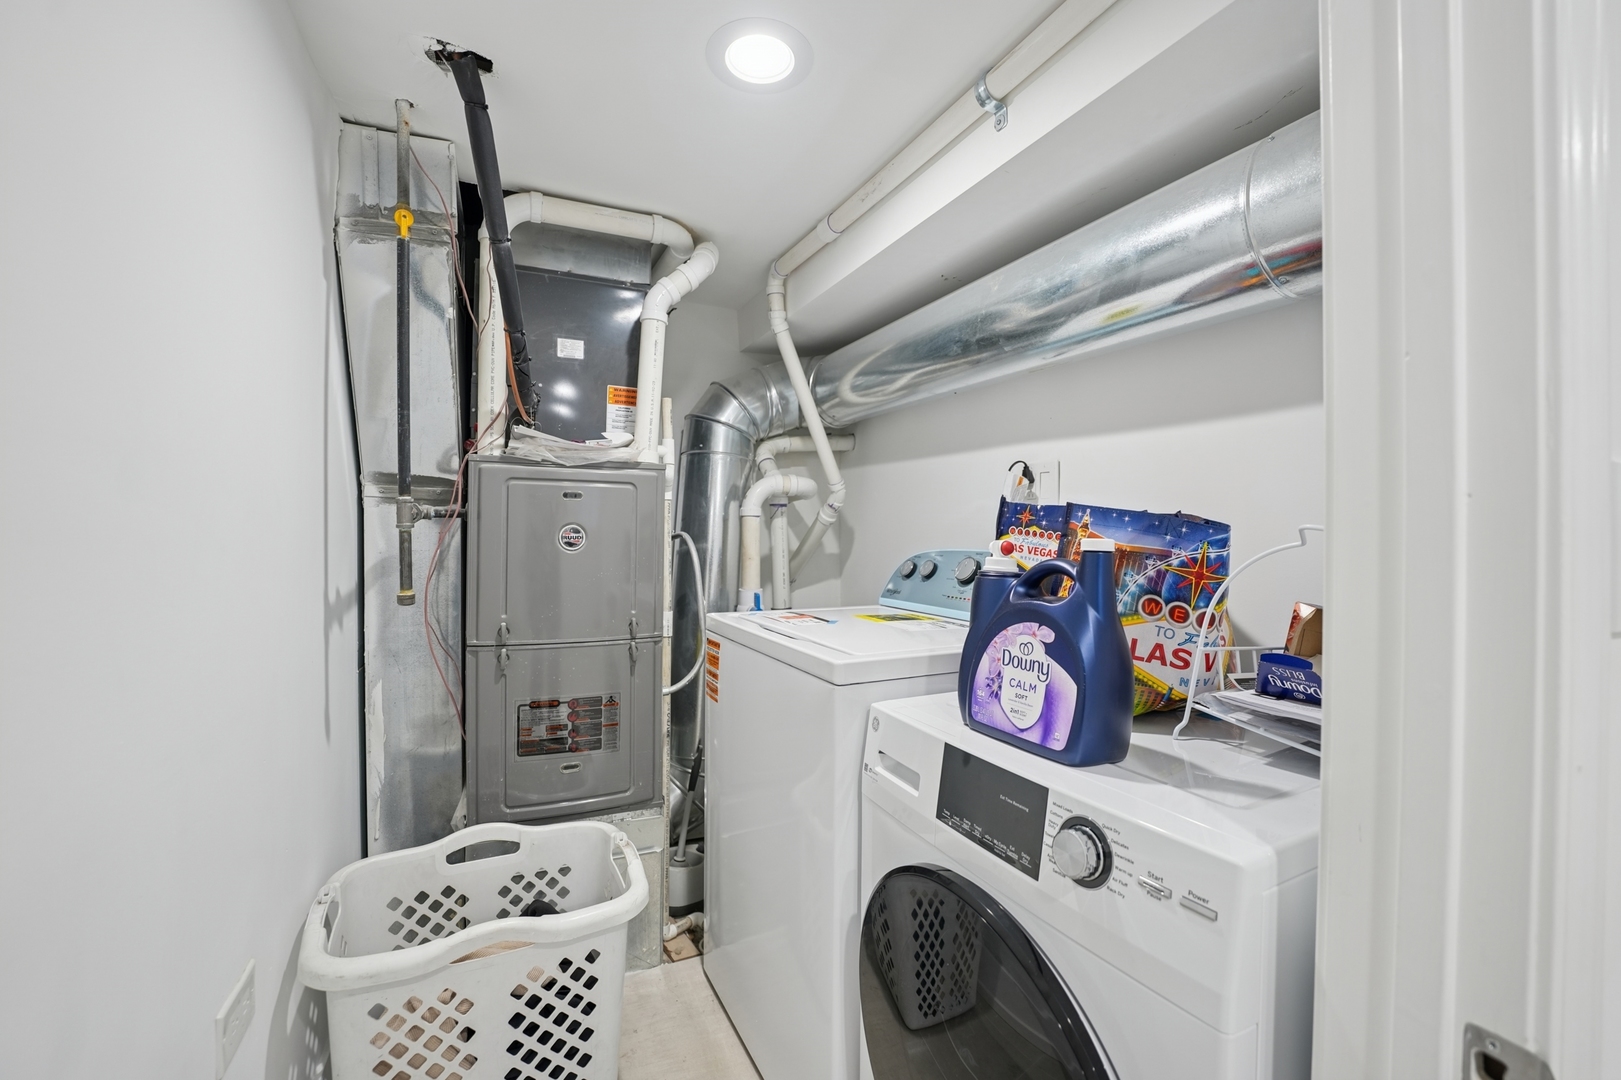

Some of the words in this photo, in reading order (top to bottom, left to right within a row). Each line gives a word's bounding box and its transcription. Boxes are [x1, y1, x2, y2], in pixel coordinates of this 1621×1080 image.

[1013, 544, 1025, 553] AS
[1027, 546, 1058, 558] VEGAS
[1155, 625, 1175, 640] TO
[1130, 638, 1192, 670] LAS
[1002, 648, 1050, 683] Downy
[1272, 666, 1305, 680] BLISS
[1009, 678, 1037, 694] CALM
[1268, 674, 1322, 699] Downy
[1015, 692, 1028, 701] SOFT
[1063, 806, 1073, 814] Loads
[1102, 823, 1113, 831] Quick
[1111, 838, 1129, 850] Delicates
[1147, 870, 1164, 883] Start
[1146, 890, 1162, 901] Pause
[1188, 889, 1209, 904] Power
